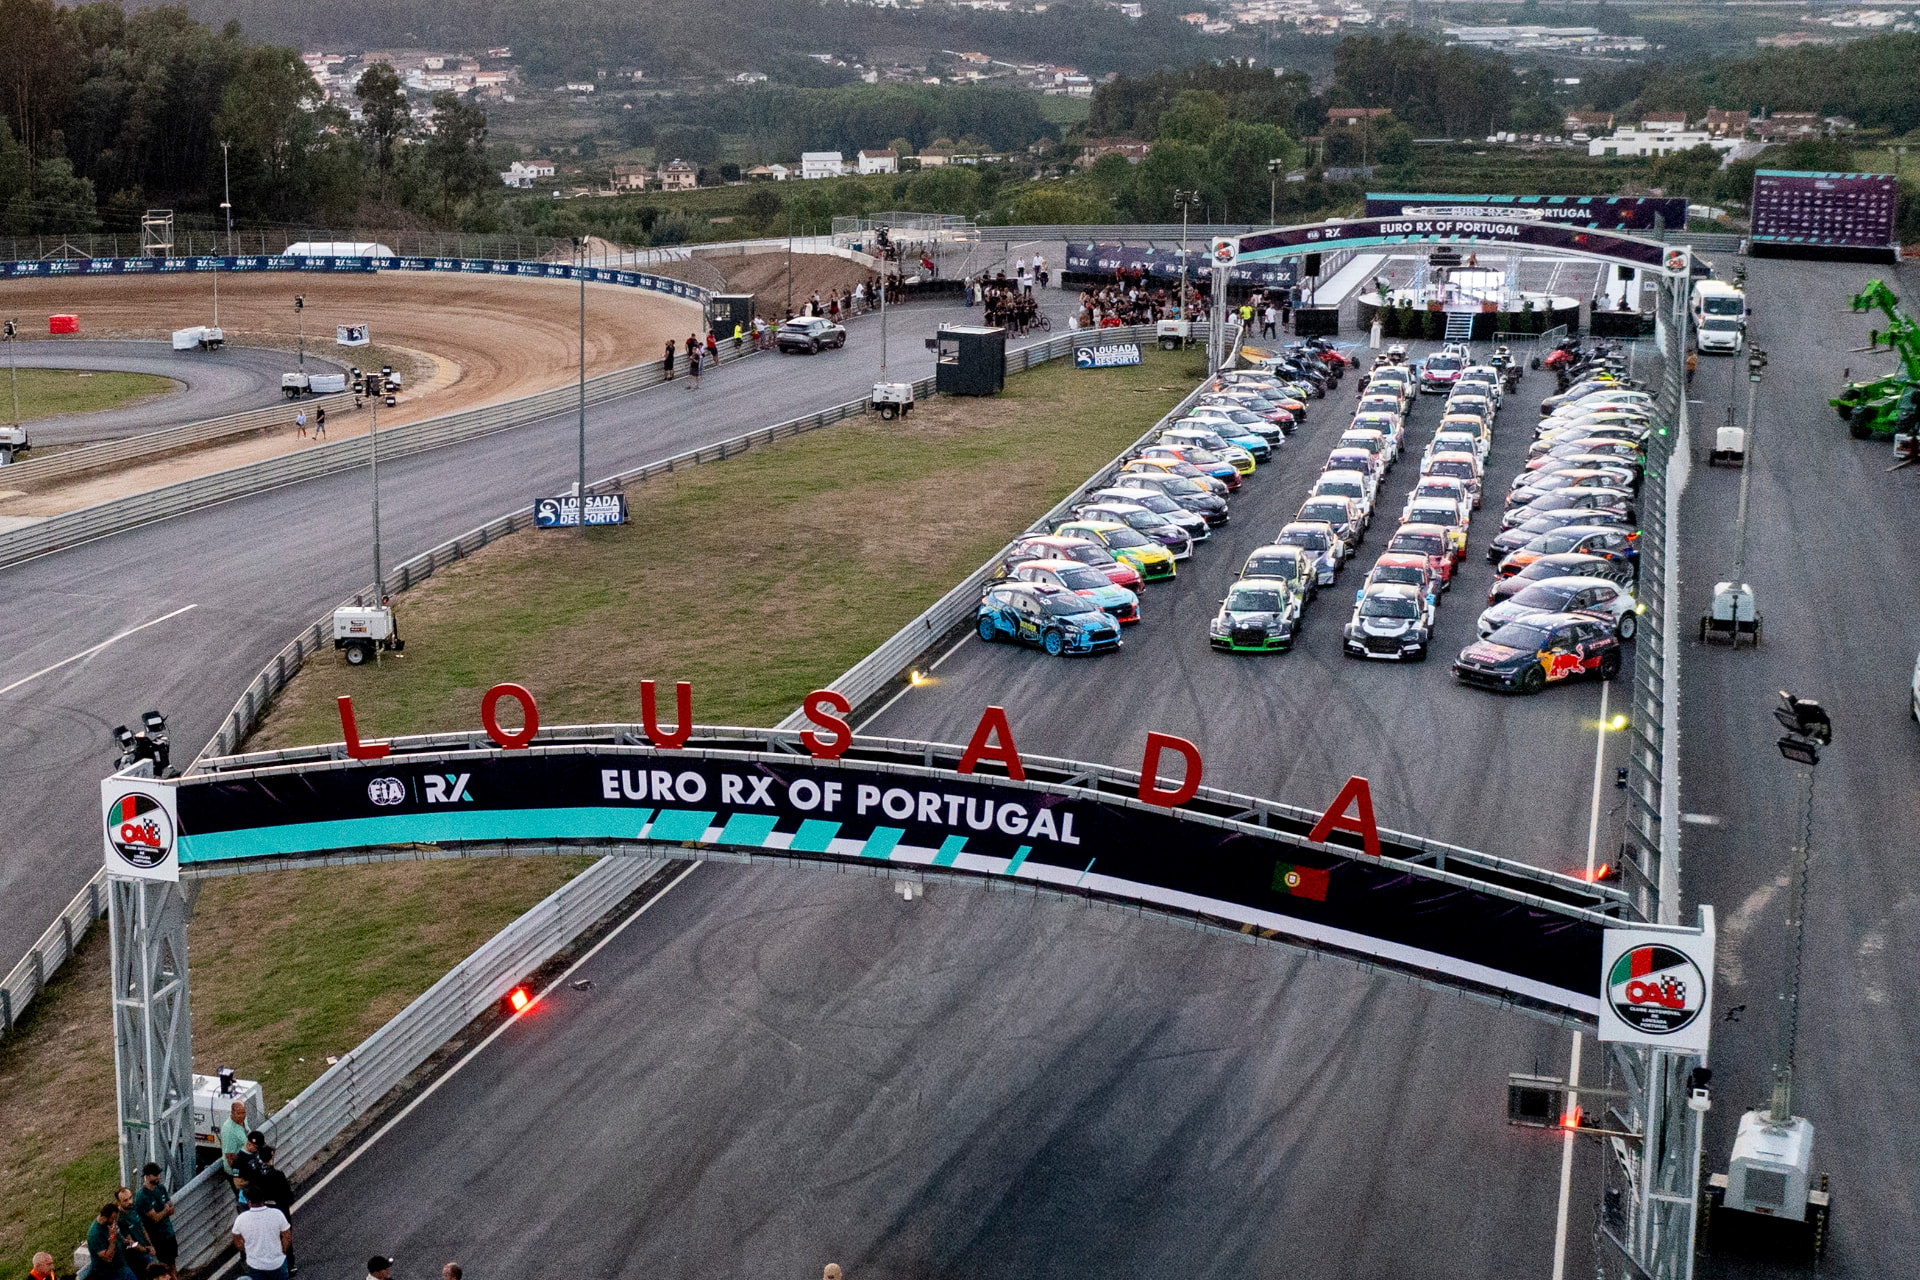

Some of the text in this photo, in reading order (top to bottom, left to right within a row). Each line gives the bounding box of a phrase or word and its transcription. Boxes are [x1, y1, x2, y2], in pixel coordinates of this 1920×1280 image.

[1325, 228, 1340, 238] RX
[1380, 221, 1520, 236] EURO RX OF PORTUGAL
[1094, 344, 1138, 354] LOUSADA
[1096, 356, 1139, 365] DESPORTO
[338, 679, 1381, 857] LOUSADA
[368, 772, 474, 804] FIA RX
[601, 768, 1081, 845] EURO RX OF PORTUGAL
